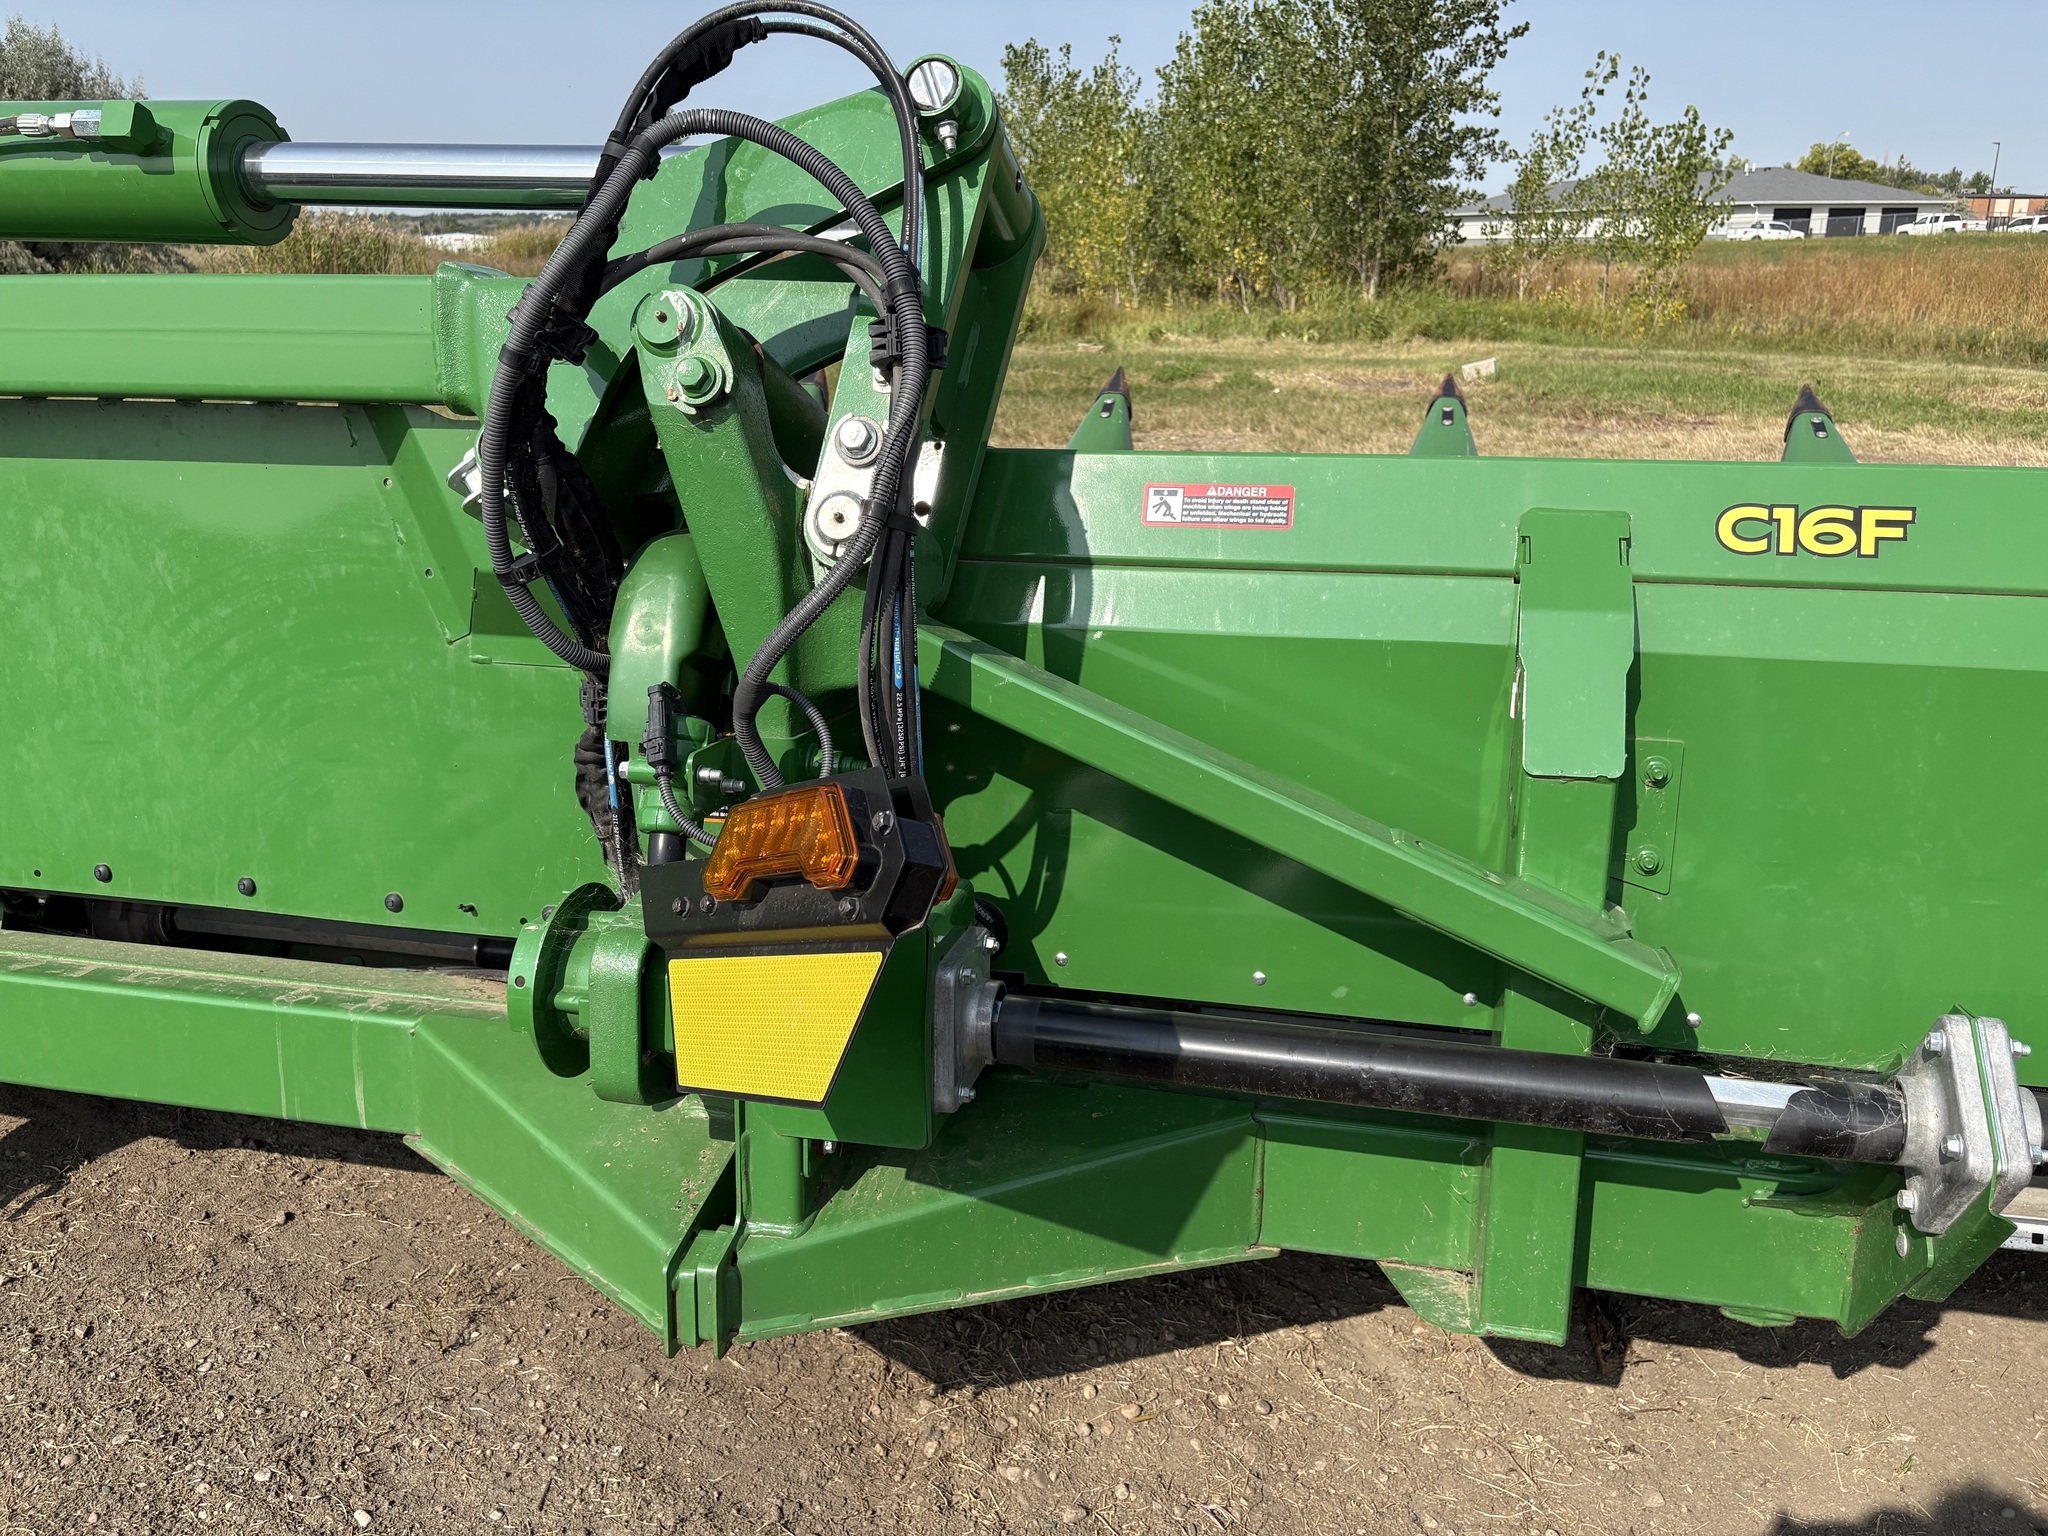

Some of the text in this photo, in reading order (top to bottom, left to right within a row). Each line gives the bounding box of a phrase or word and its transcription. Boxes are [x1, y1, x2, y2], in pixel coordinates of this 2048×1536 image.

[1217, 486, 1267, 497] DANGER
[1715, 503, 1917, 558] C16F
[525, 536, 535, 549] 22.5
